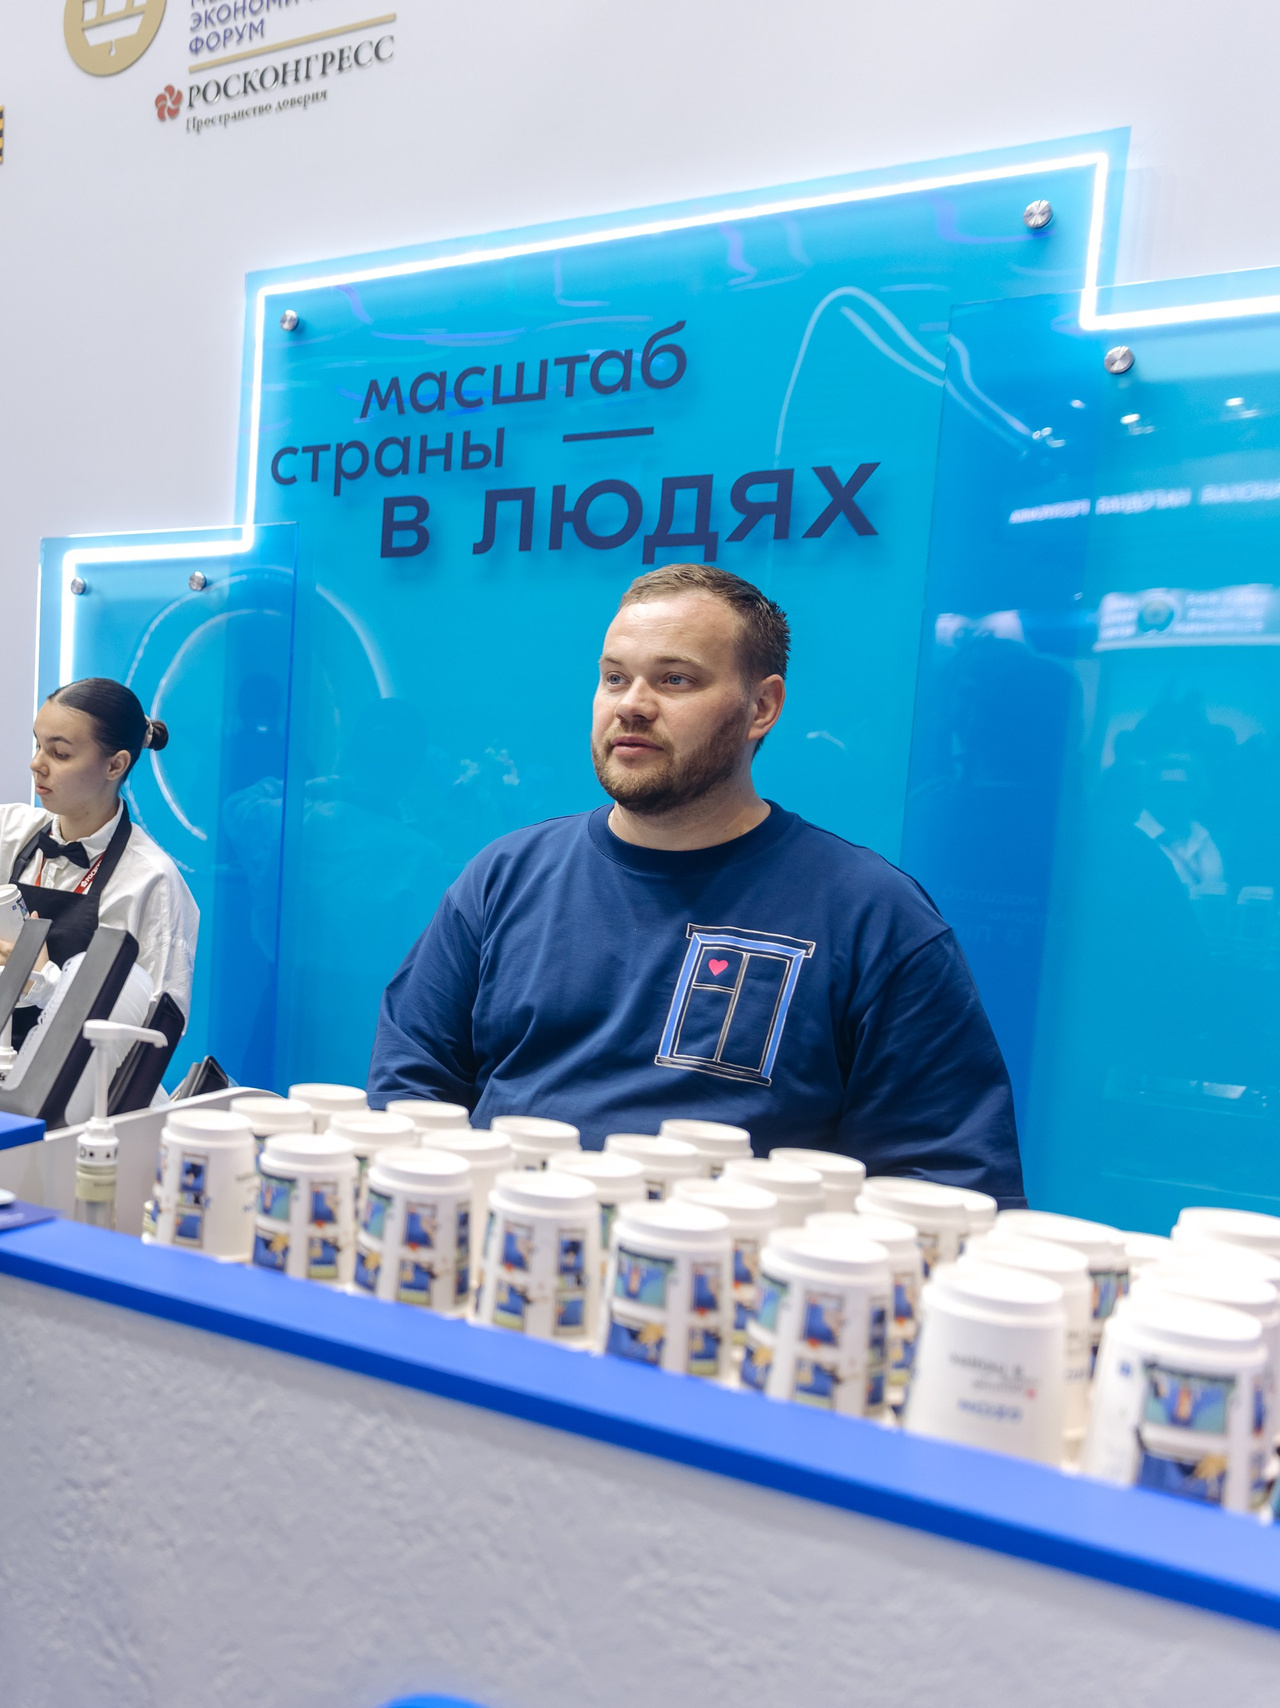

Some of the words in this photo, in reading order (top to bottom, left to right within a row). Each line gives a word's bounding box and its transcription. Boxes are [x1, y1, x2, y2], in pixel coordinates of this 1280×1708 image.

[189, 18, 265, 56] ФОРУМ
[187, 35, 396, 110] РОСКОНГРЕСС
[186, 103, 272, 134] Пространство
[275, 88, 328, 111] доверия
[359, 320, 687, 419] масштаб
[270, 426, 506, 496] страны
